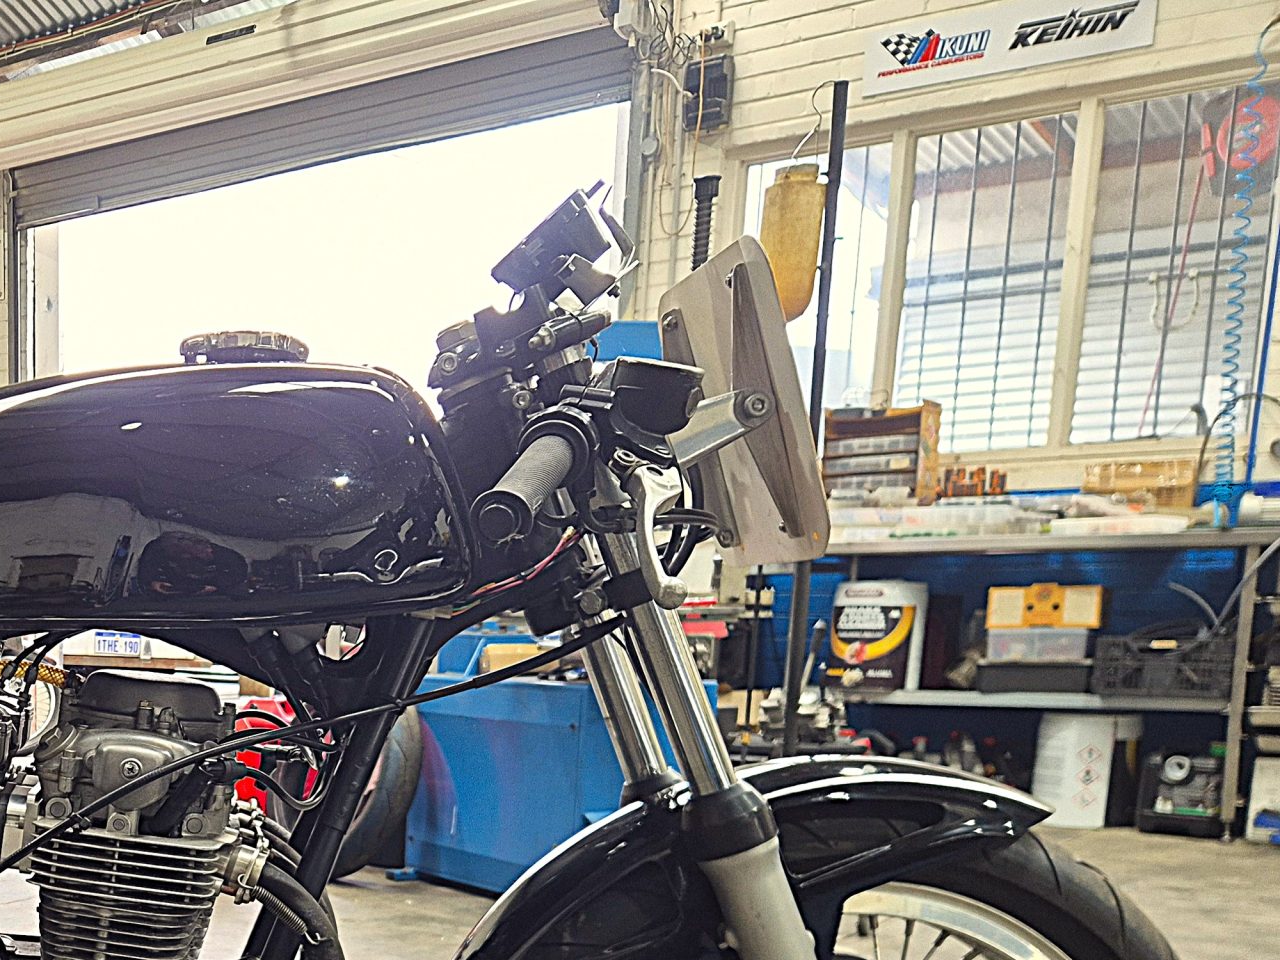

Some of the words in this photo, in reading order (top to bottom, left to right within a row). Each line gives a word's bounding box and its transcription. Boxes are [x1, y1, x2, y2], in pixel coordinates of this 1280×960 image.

[1008, 5, 1137, 50] KEIHIN
[877, 62, 929, 78] PERFORMANCE
[97, 639, 119, 652] 1THE
[124, 640, 139, 653] 190
